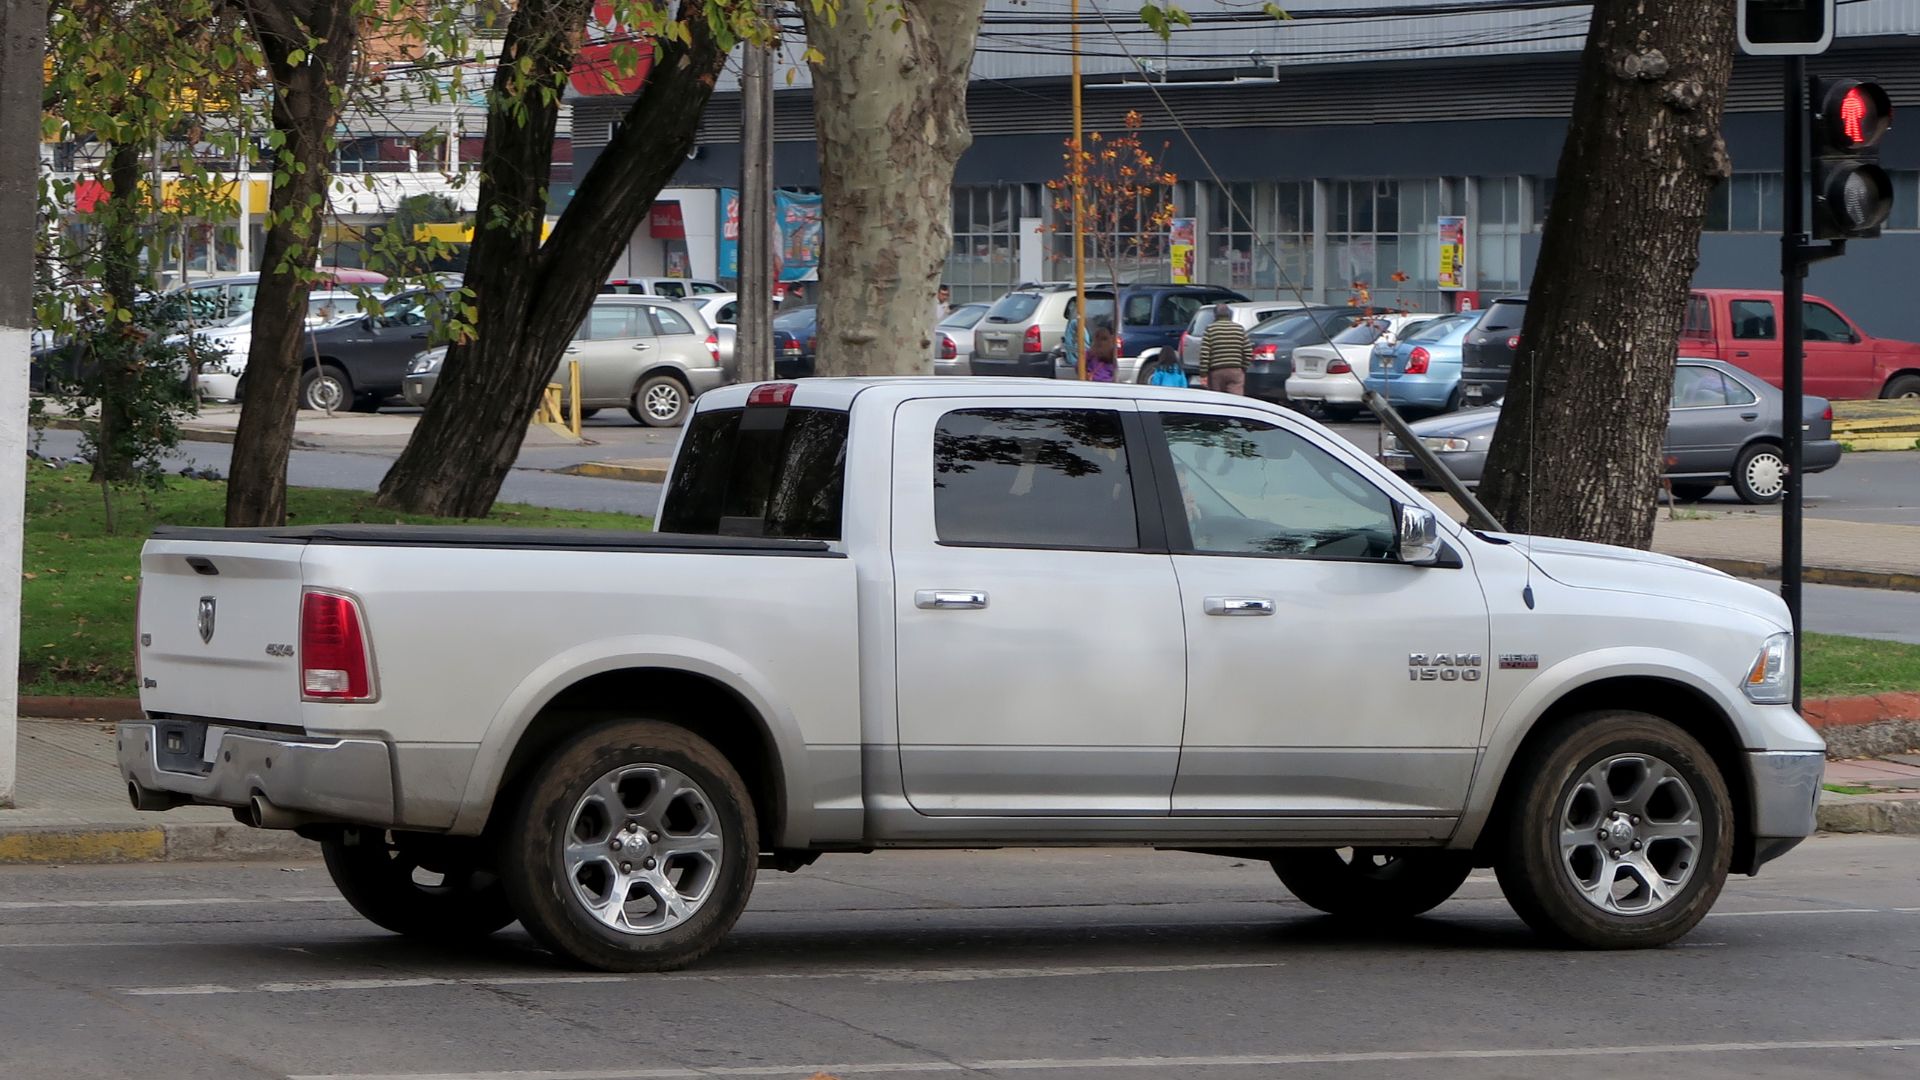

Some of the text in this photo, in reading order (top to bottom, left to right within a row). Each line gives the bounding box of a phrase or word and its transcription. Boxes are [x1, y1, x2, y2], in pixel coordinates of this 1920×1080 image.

[1408, 653, 1482, 666] RAM
[1499, 654, 1537, 662] HEMI
[1409, 668, 1482, 681] 1500
